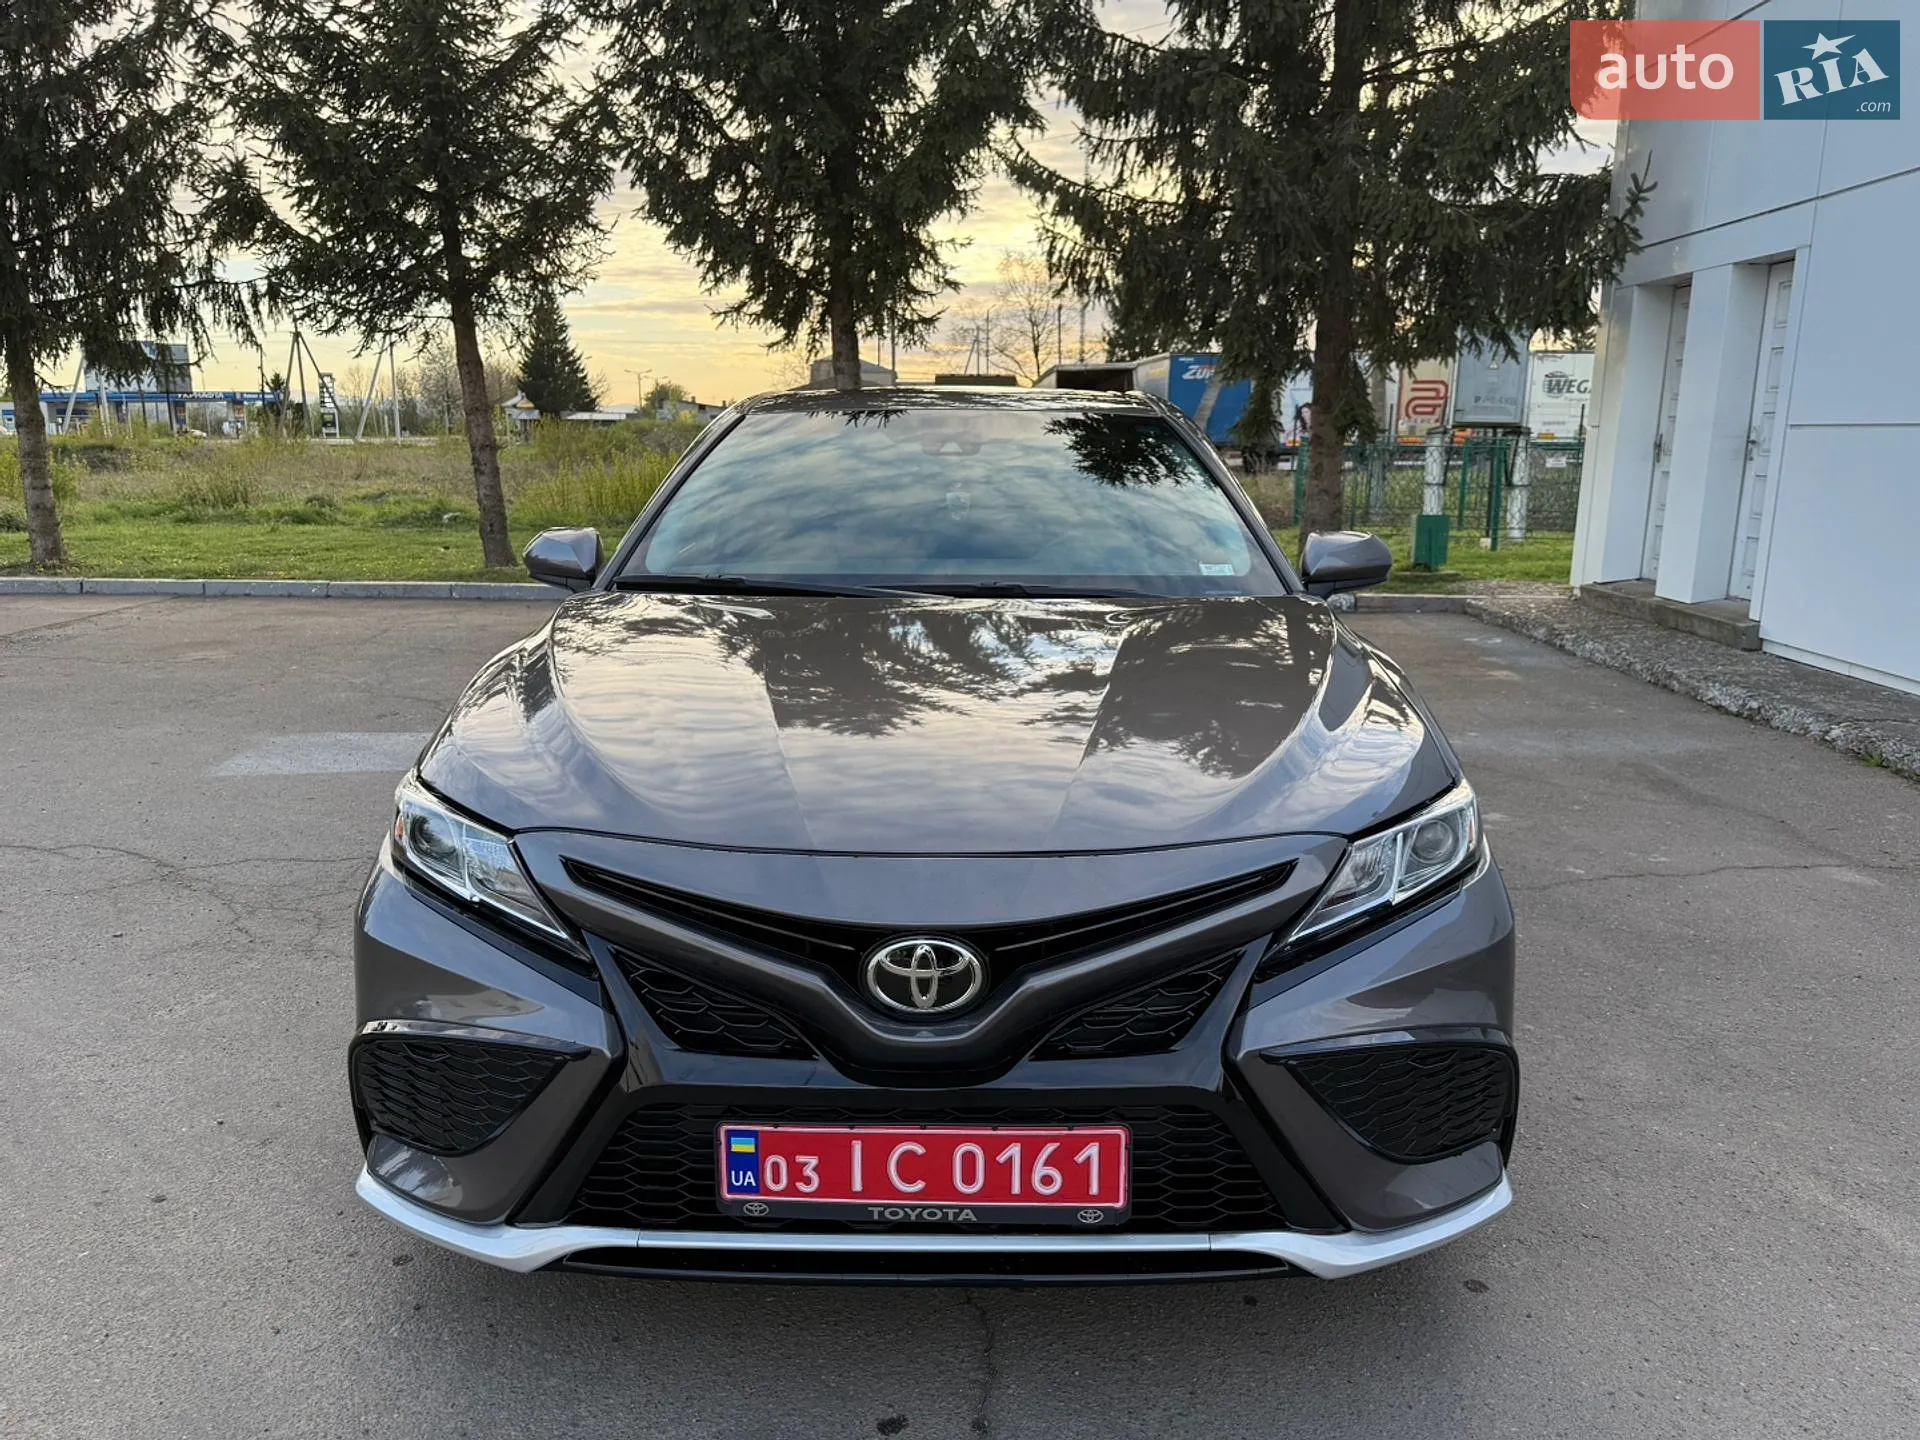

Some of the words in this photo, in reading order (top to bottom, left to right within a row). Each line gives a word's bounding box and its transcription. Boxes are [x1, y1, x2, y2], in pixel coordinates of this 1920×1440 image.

[1546, 379, 1592, 394] WEG
[763, 1155, 820, 1193] 03
[953, 1142, 1101, 1196] 0161
[731, 1170, 756, 1187] UA
[868, 1206, 978, 1222] TOYOTA
